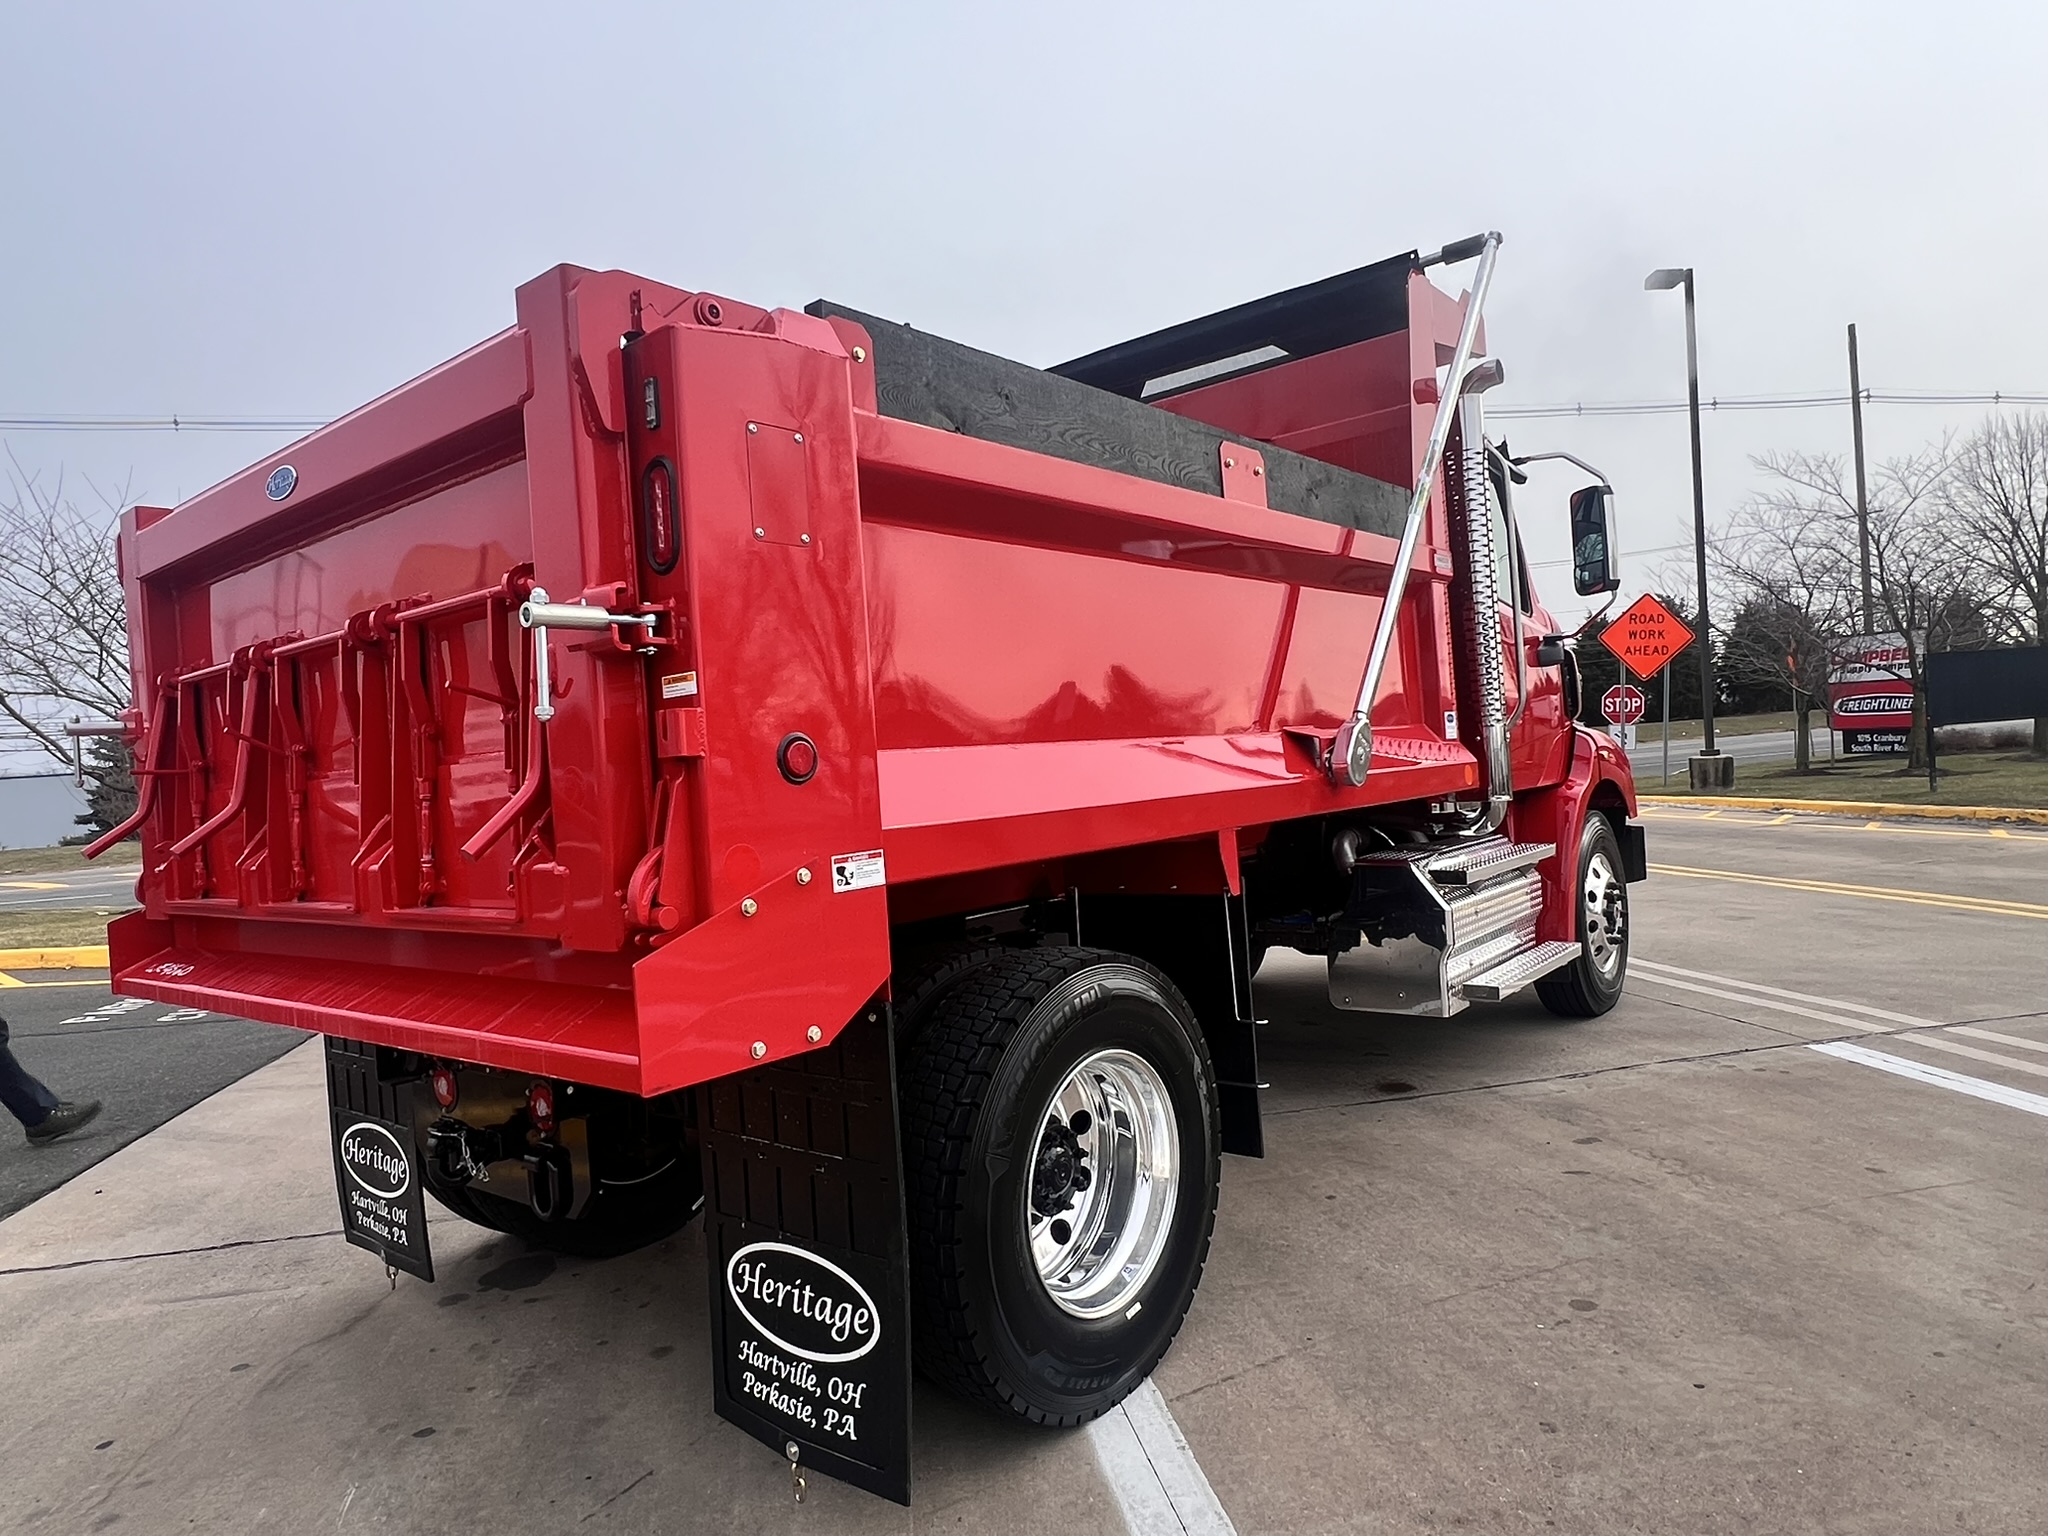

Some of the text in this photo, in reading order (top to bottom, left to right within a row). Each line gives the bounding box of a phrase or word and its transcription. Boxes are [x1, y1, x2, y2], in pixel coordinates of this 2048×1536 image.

[1629, 613, 1665, 625] ROAD
[1628, 629, 1666, 640] WORK
[1624, 645, 1670, 656] AHEAD
[1605, 697, 1641, 713] STOP
[1851, 743, 1872, 752] South
[1873, 743, 1892, 752] River
[1872, 732, 1907, 744] Cranbury
[346, 1137, 406, 1185] Heritage
[351, 1190, 408, 1226] Hartville, OH
[356, 1210, 409, 1247] Perkasie, PA
[735, 1262, 870, 1342] Heritage
[738, 1340, 867, 1409] Hartville, OH
[742, 1371, 858, 1441] Perkasie, PA
